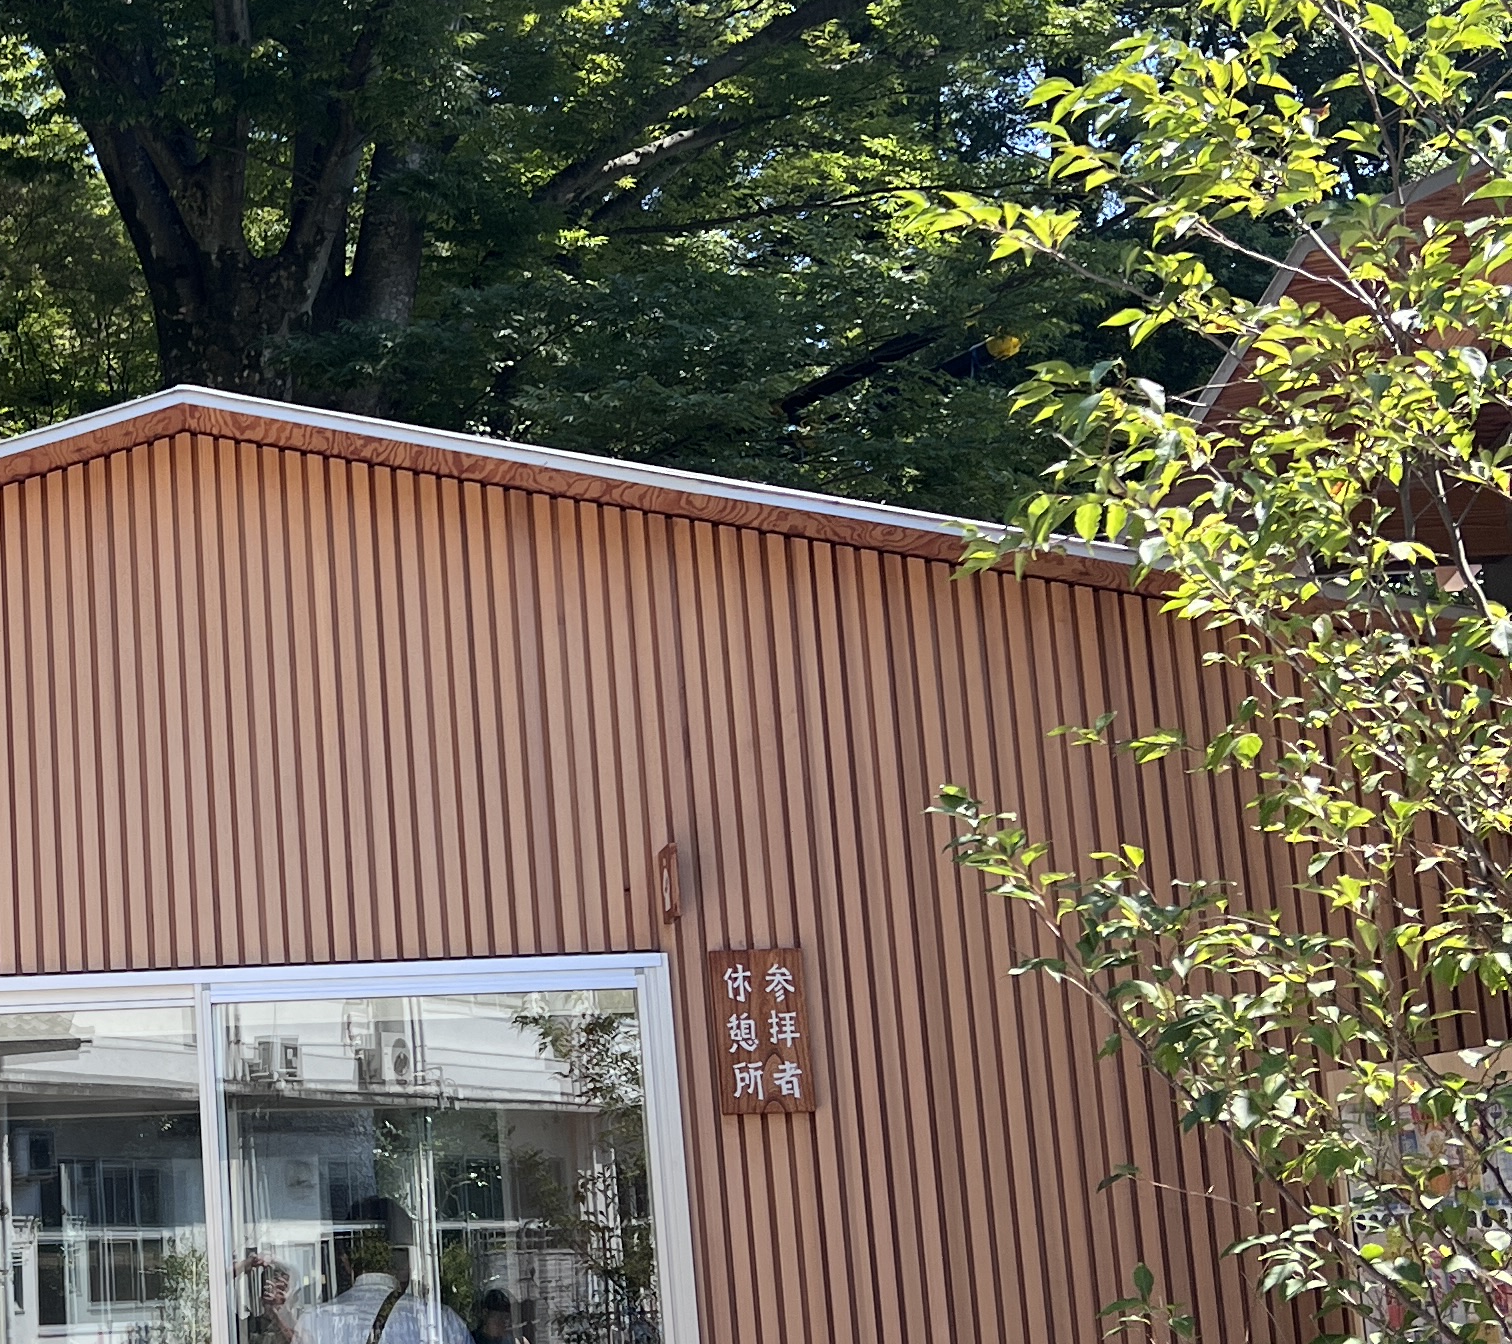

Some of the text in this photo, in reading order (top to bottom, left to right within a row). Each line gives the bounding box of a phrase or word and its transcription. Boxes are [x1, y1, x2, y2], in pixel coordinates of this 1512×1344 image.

[723, 963, 764, 1101] 休憩所
[765, 963, 803, 1099] 参拝者
